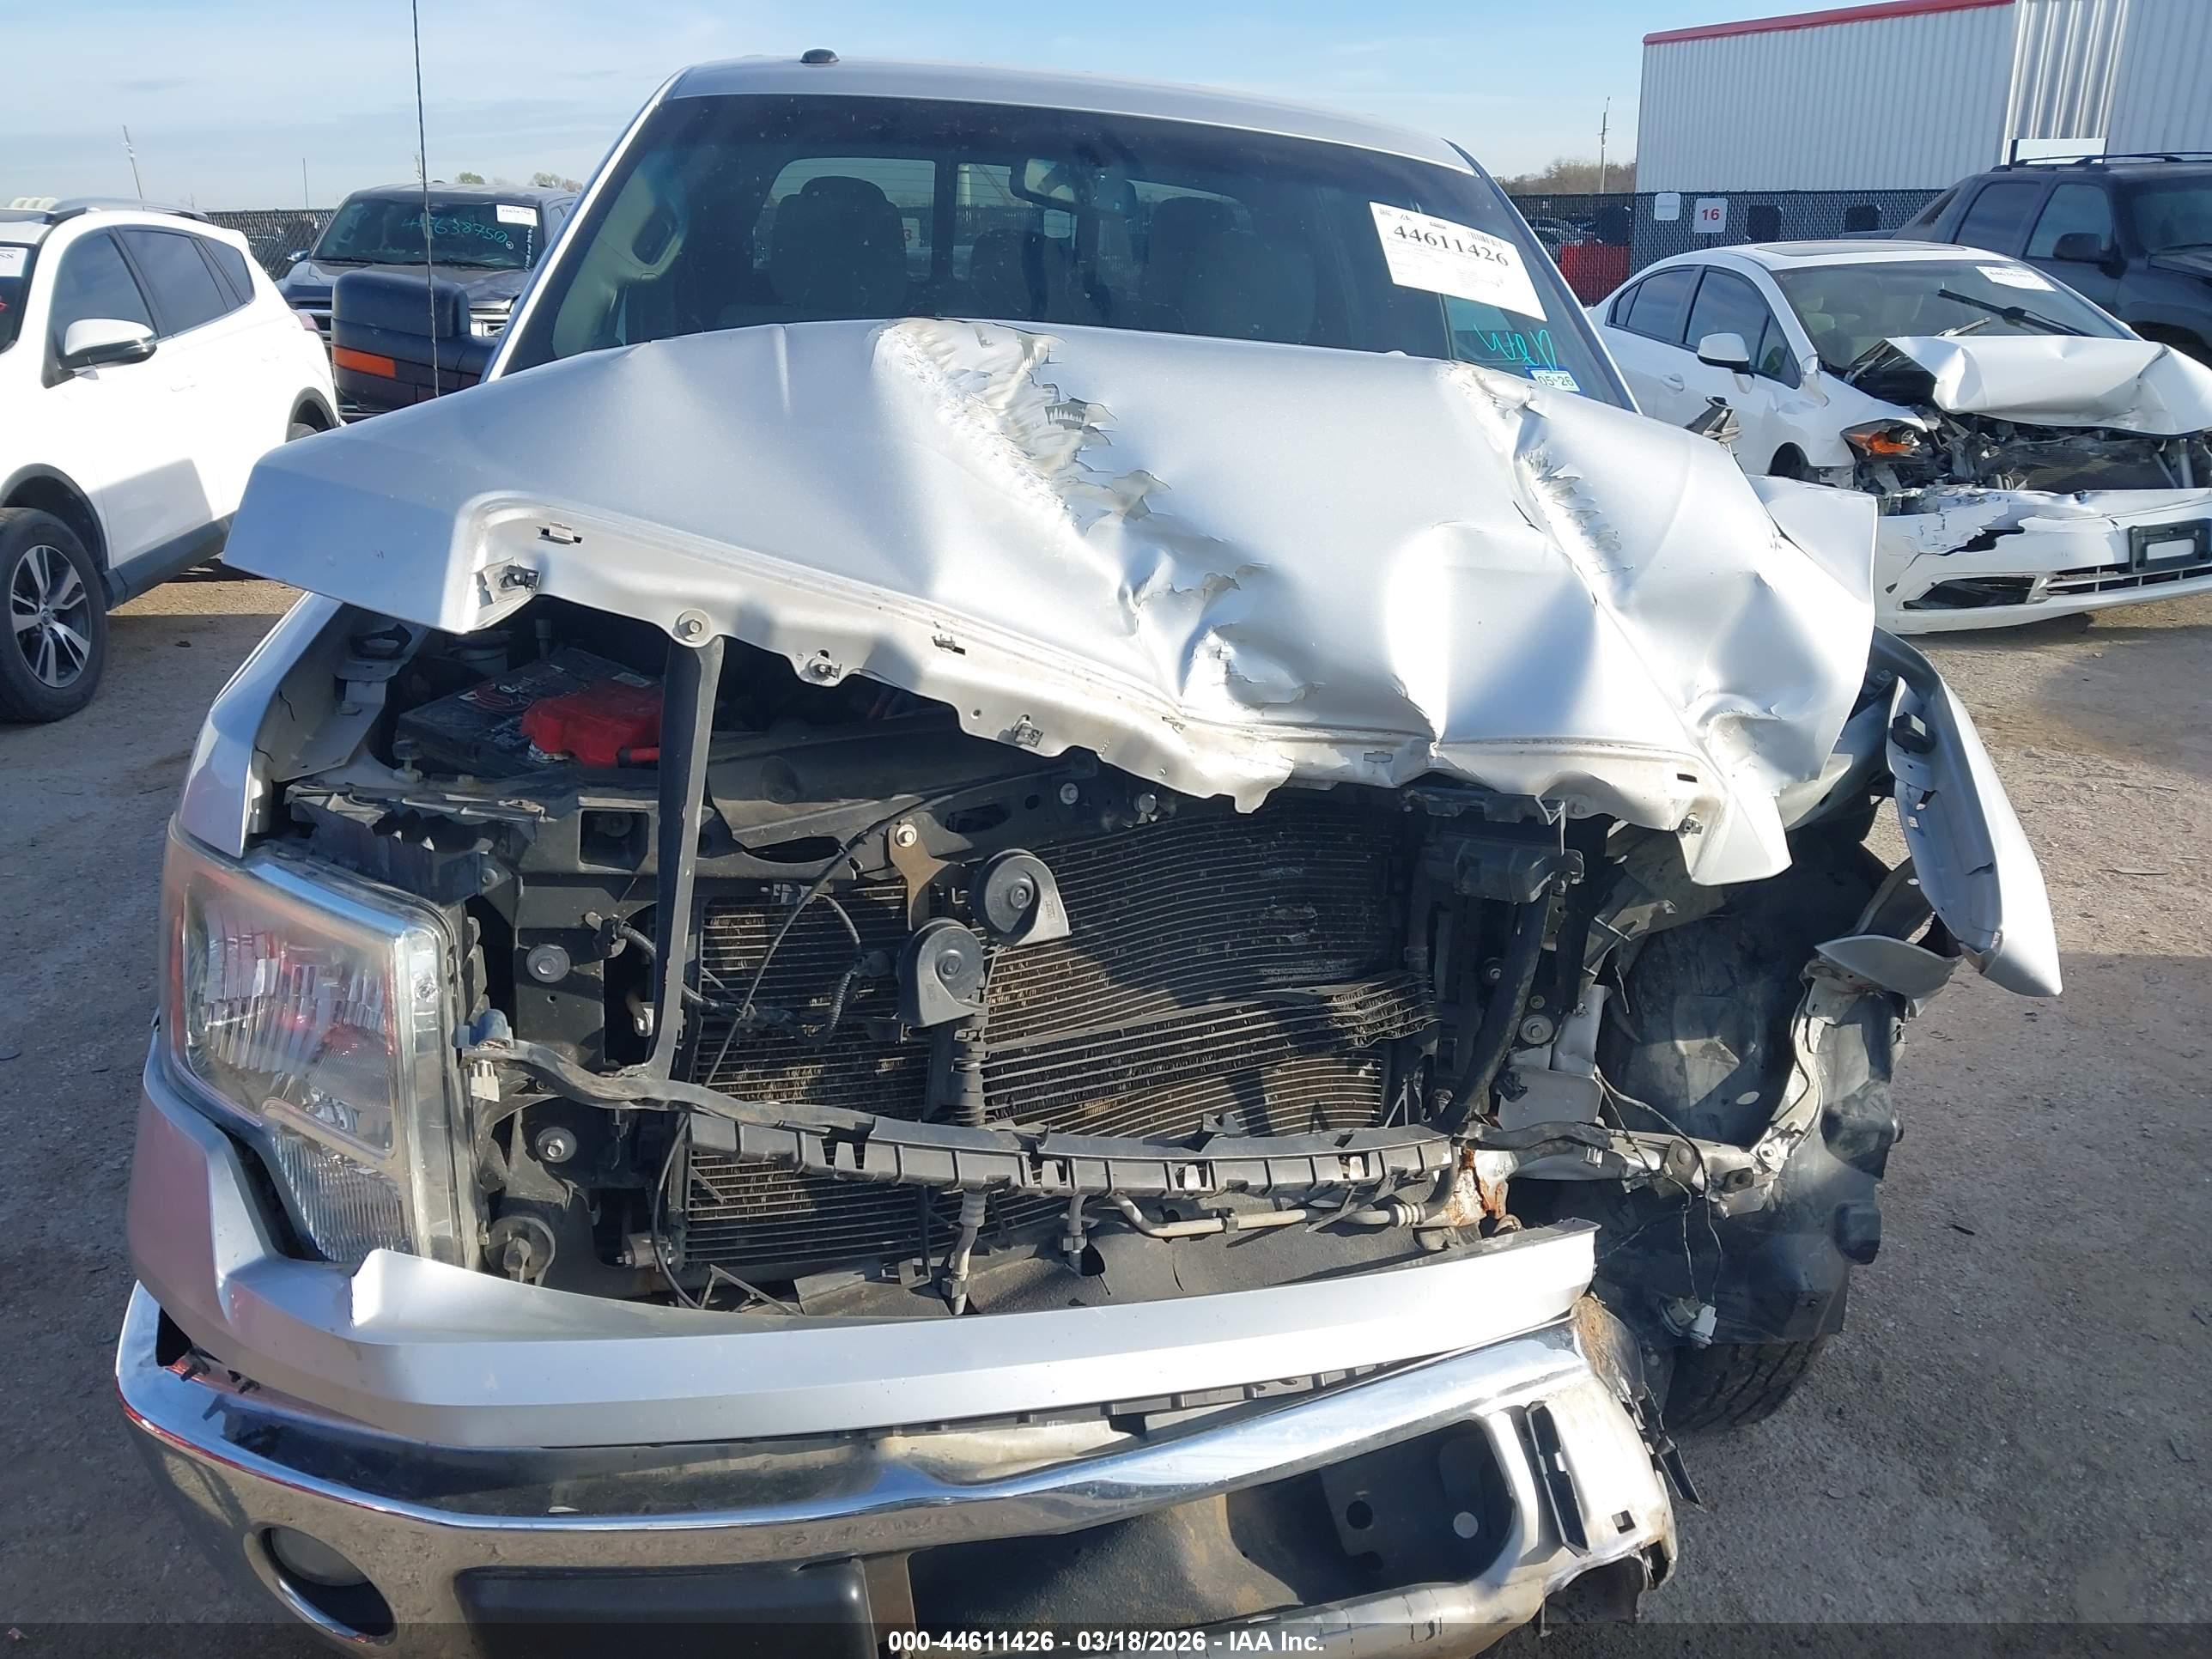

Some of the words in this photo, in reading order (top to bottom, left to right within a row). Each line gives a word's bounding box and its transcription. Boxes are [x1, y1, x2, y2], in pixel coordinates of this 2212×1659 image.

[1702, 209, 1720, 221] 16
[1394, 225, 1509, 266] 44611426
[1557, 376, 1574, 386] 26
